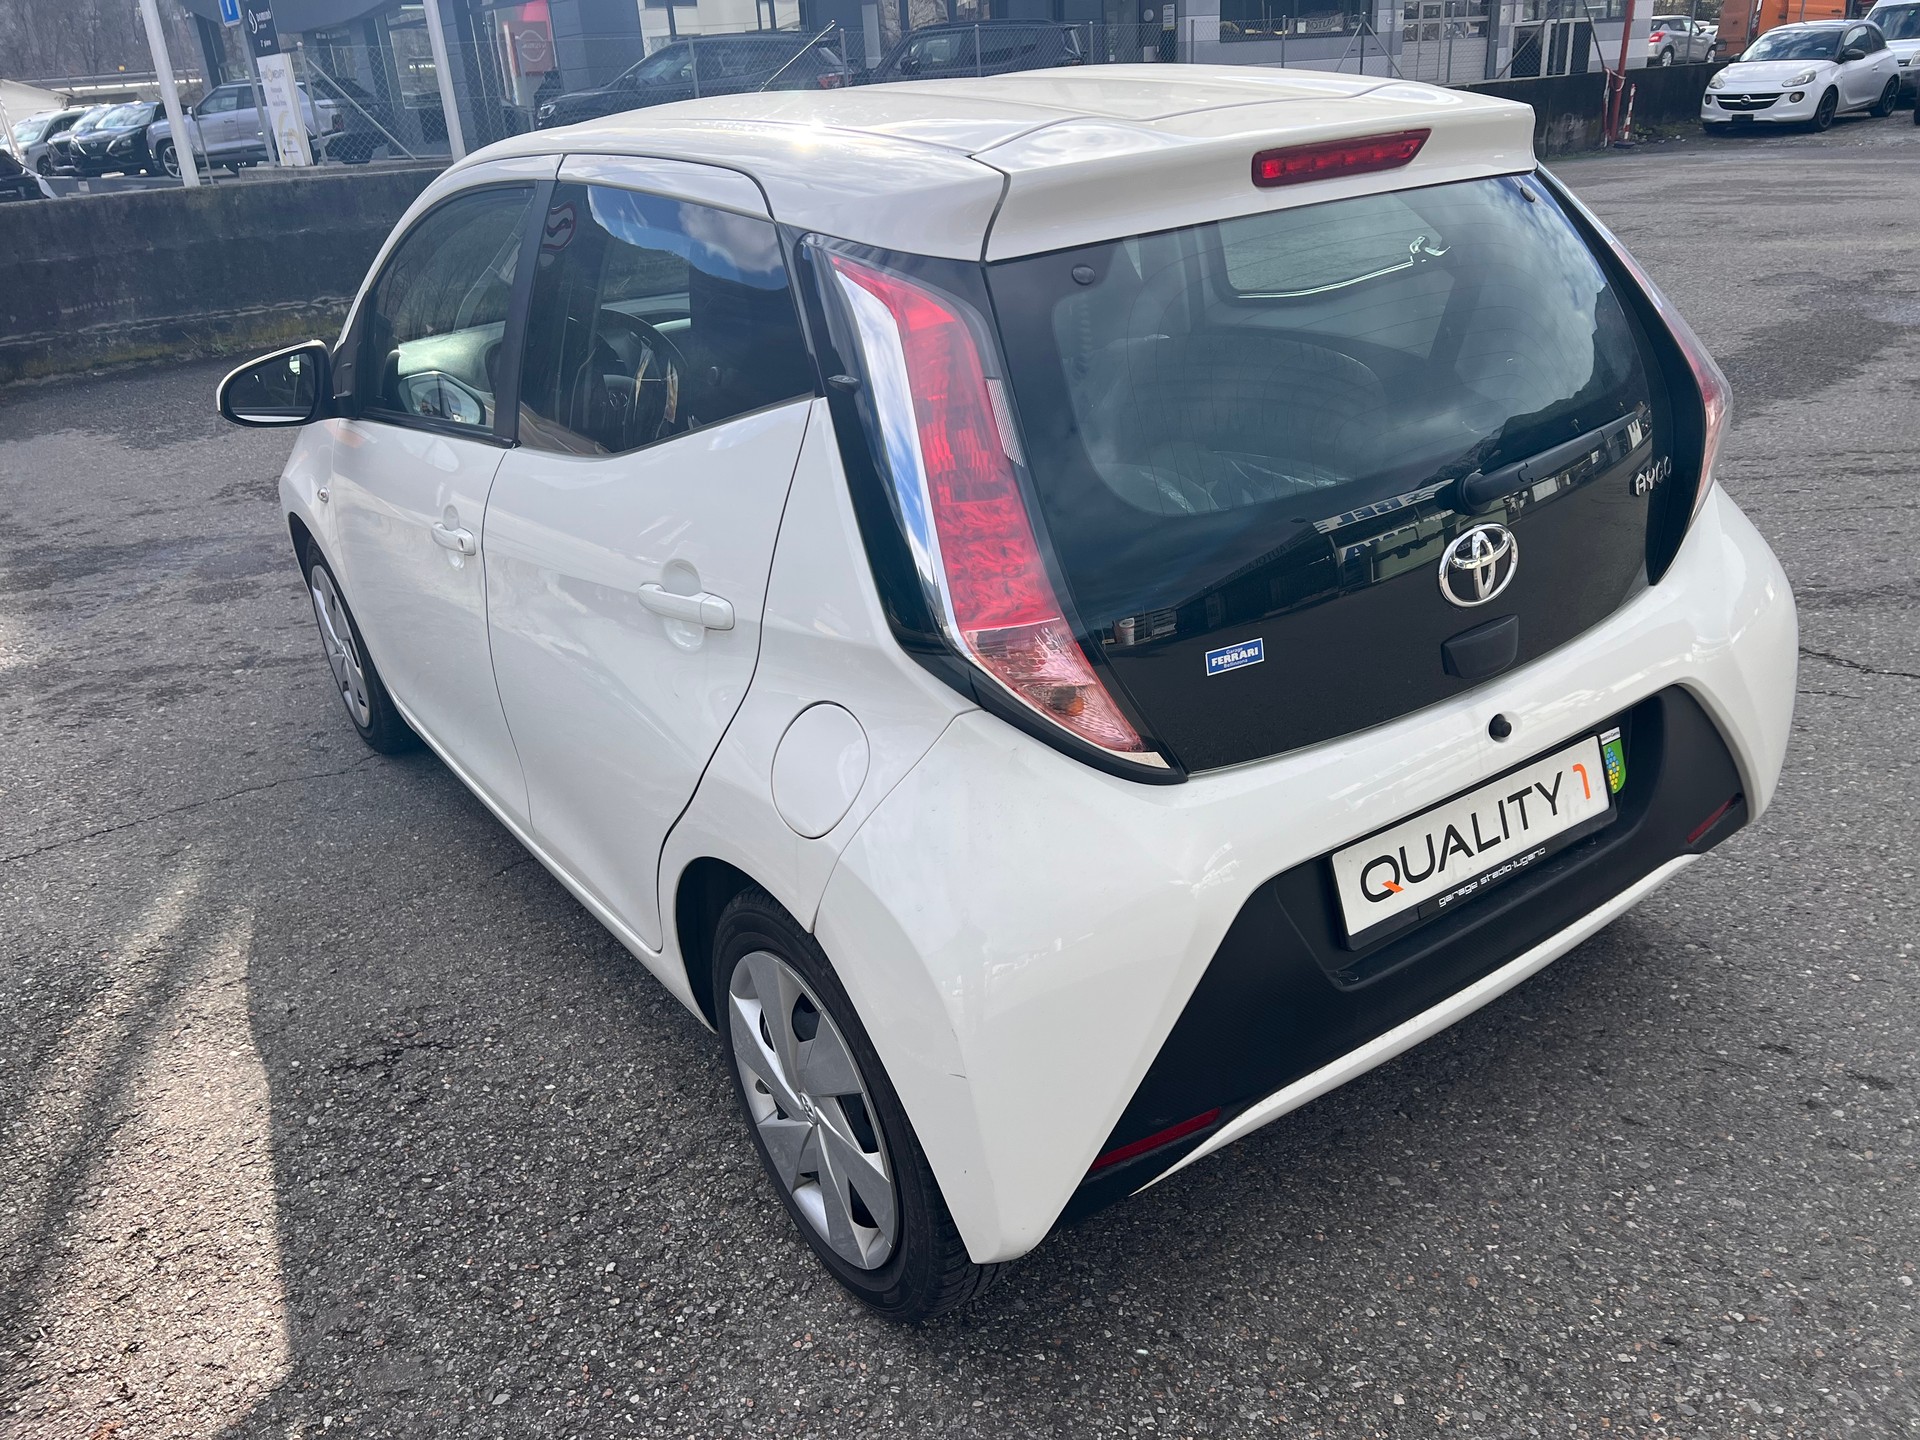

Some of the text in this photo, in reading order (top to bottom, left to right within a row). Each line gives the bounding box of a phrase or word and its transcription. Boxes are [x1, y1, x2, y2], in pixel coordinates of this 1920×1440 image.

[1635, 456, 1671, 496] AYGO
[1211, 646, 1259, 667] FERRARI
[1226, 647, 1243, 655] Garage
[1223, 658, 1248, 669] Bellinzona
[1360, 763, 1591, 902] QUALITY 1
[1438, 881, 1479, 907] garage
